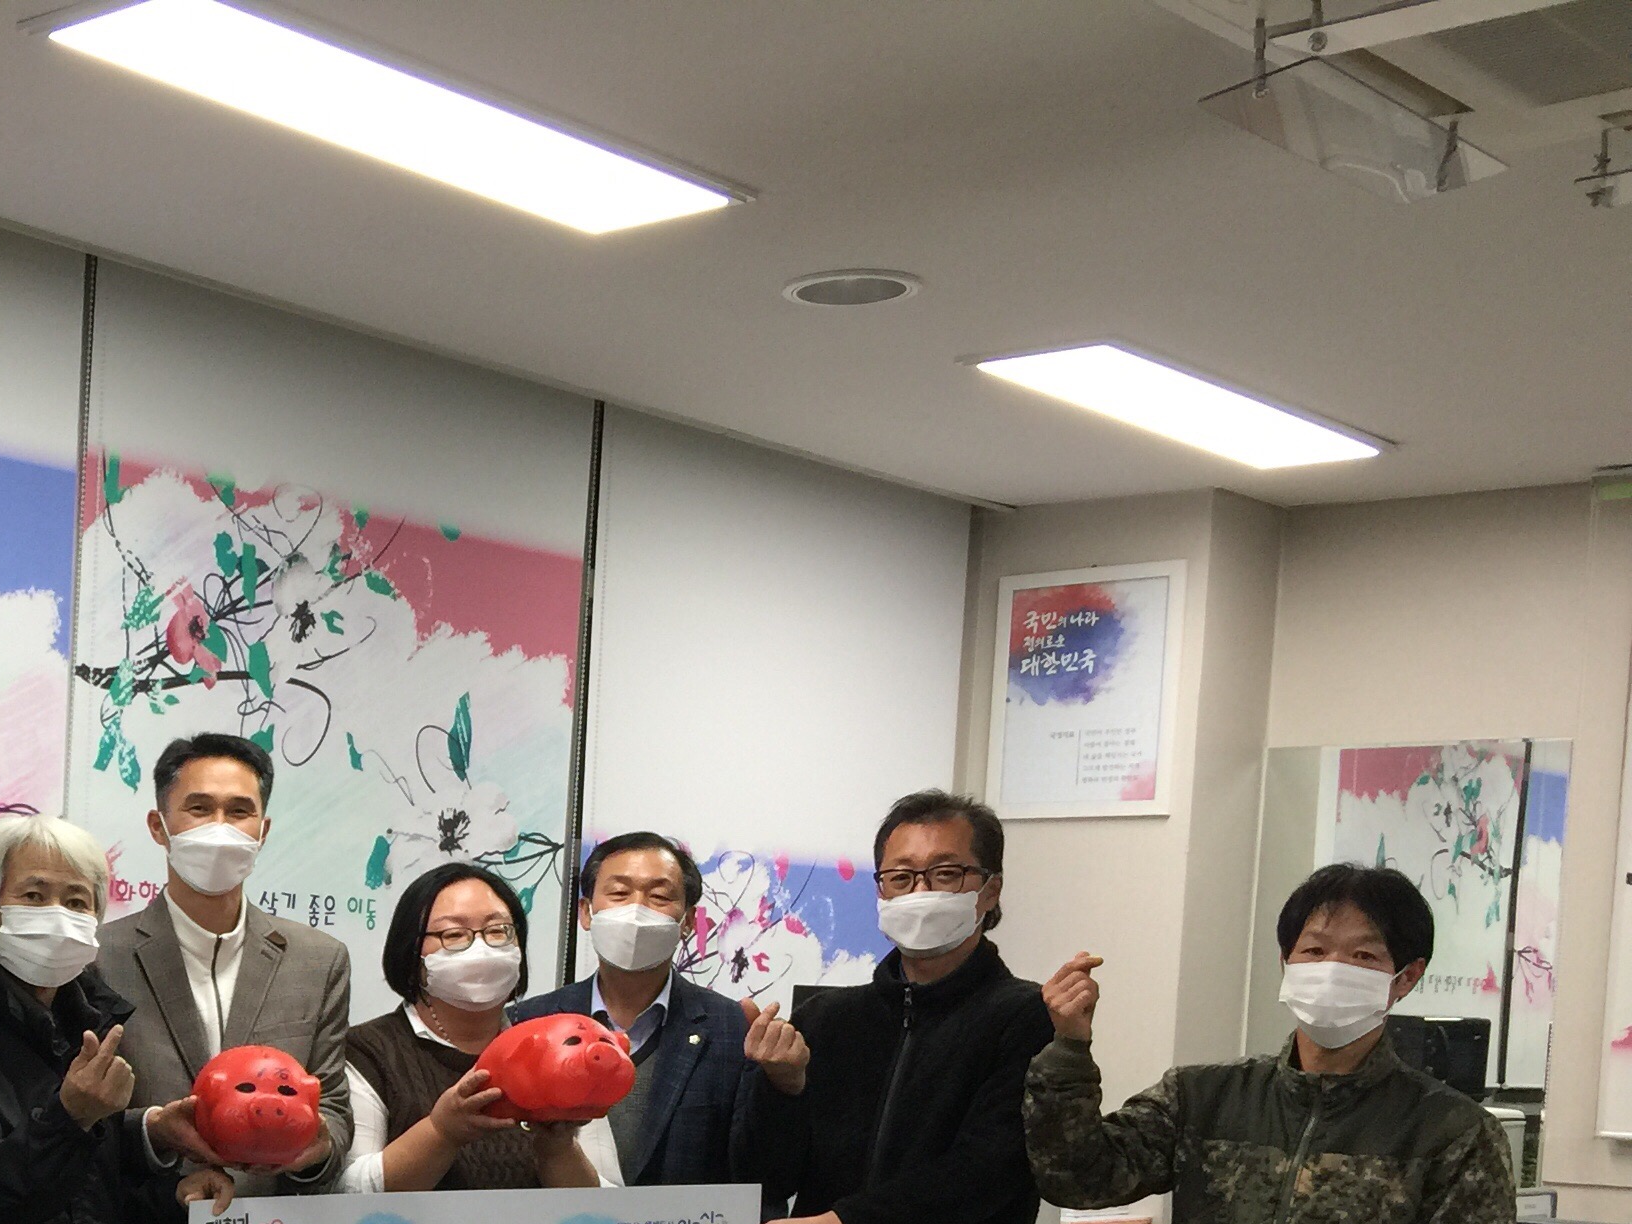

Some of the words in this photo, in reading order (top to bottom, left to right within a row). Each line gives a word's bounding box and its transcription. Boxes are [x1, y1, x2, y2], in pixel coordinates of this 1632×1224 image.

[1070, 611, 1100, 626] 나라
[1020, 648, 1097, 676] 대한민국
[309, 894, 336, 928] 좋은
[347, 897, 376, 930] 이동
